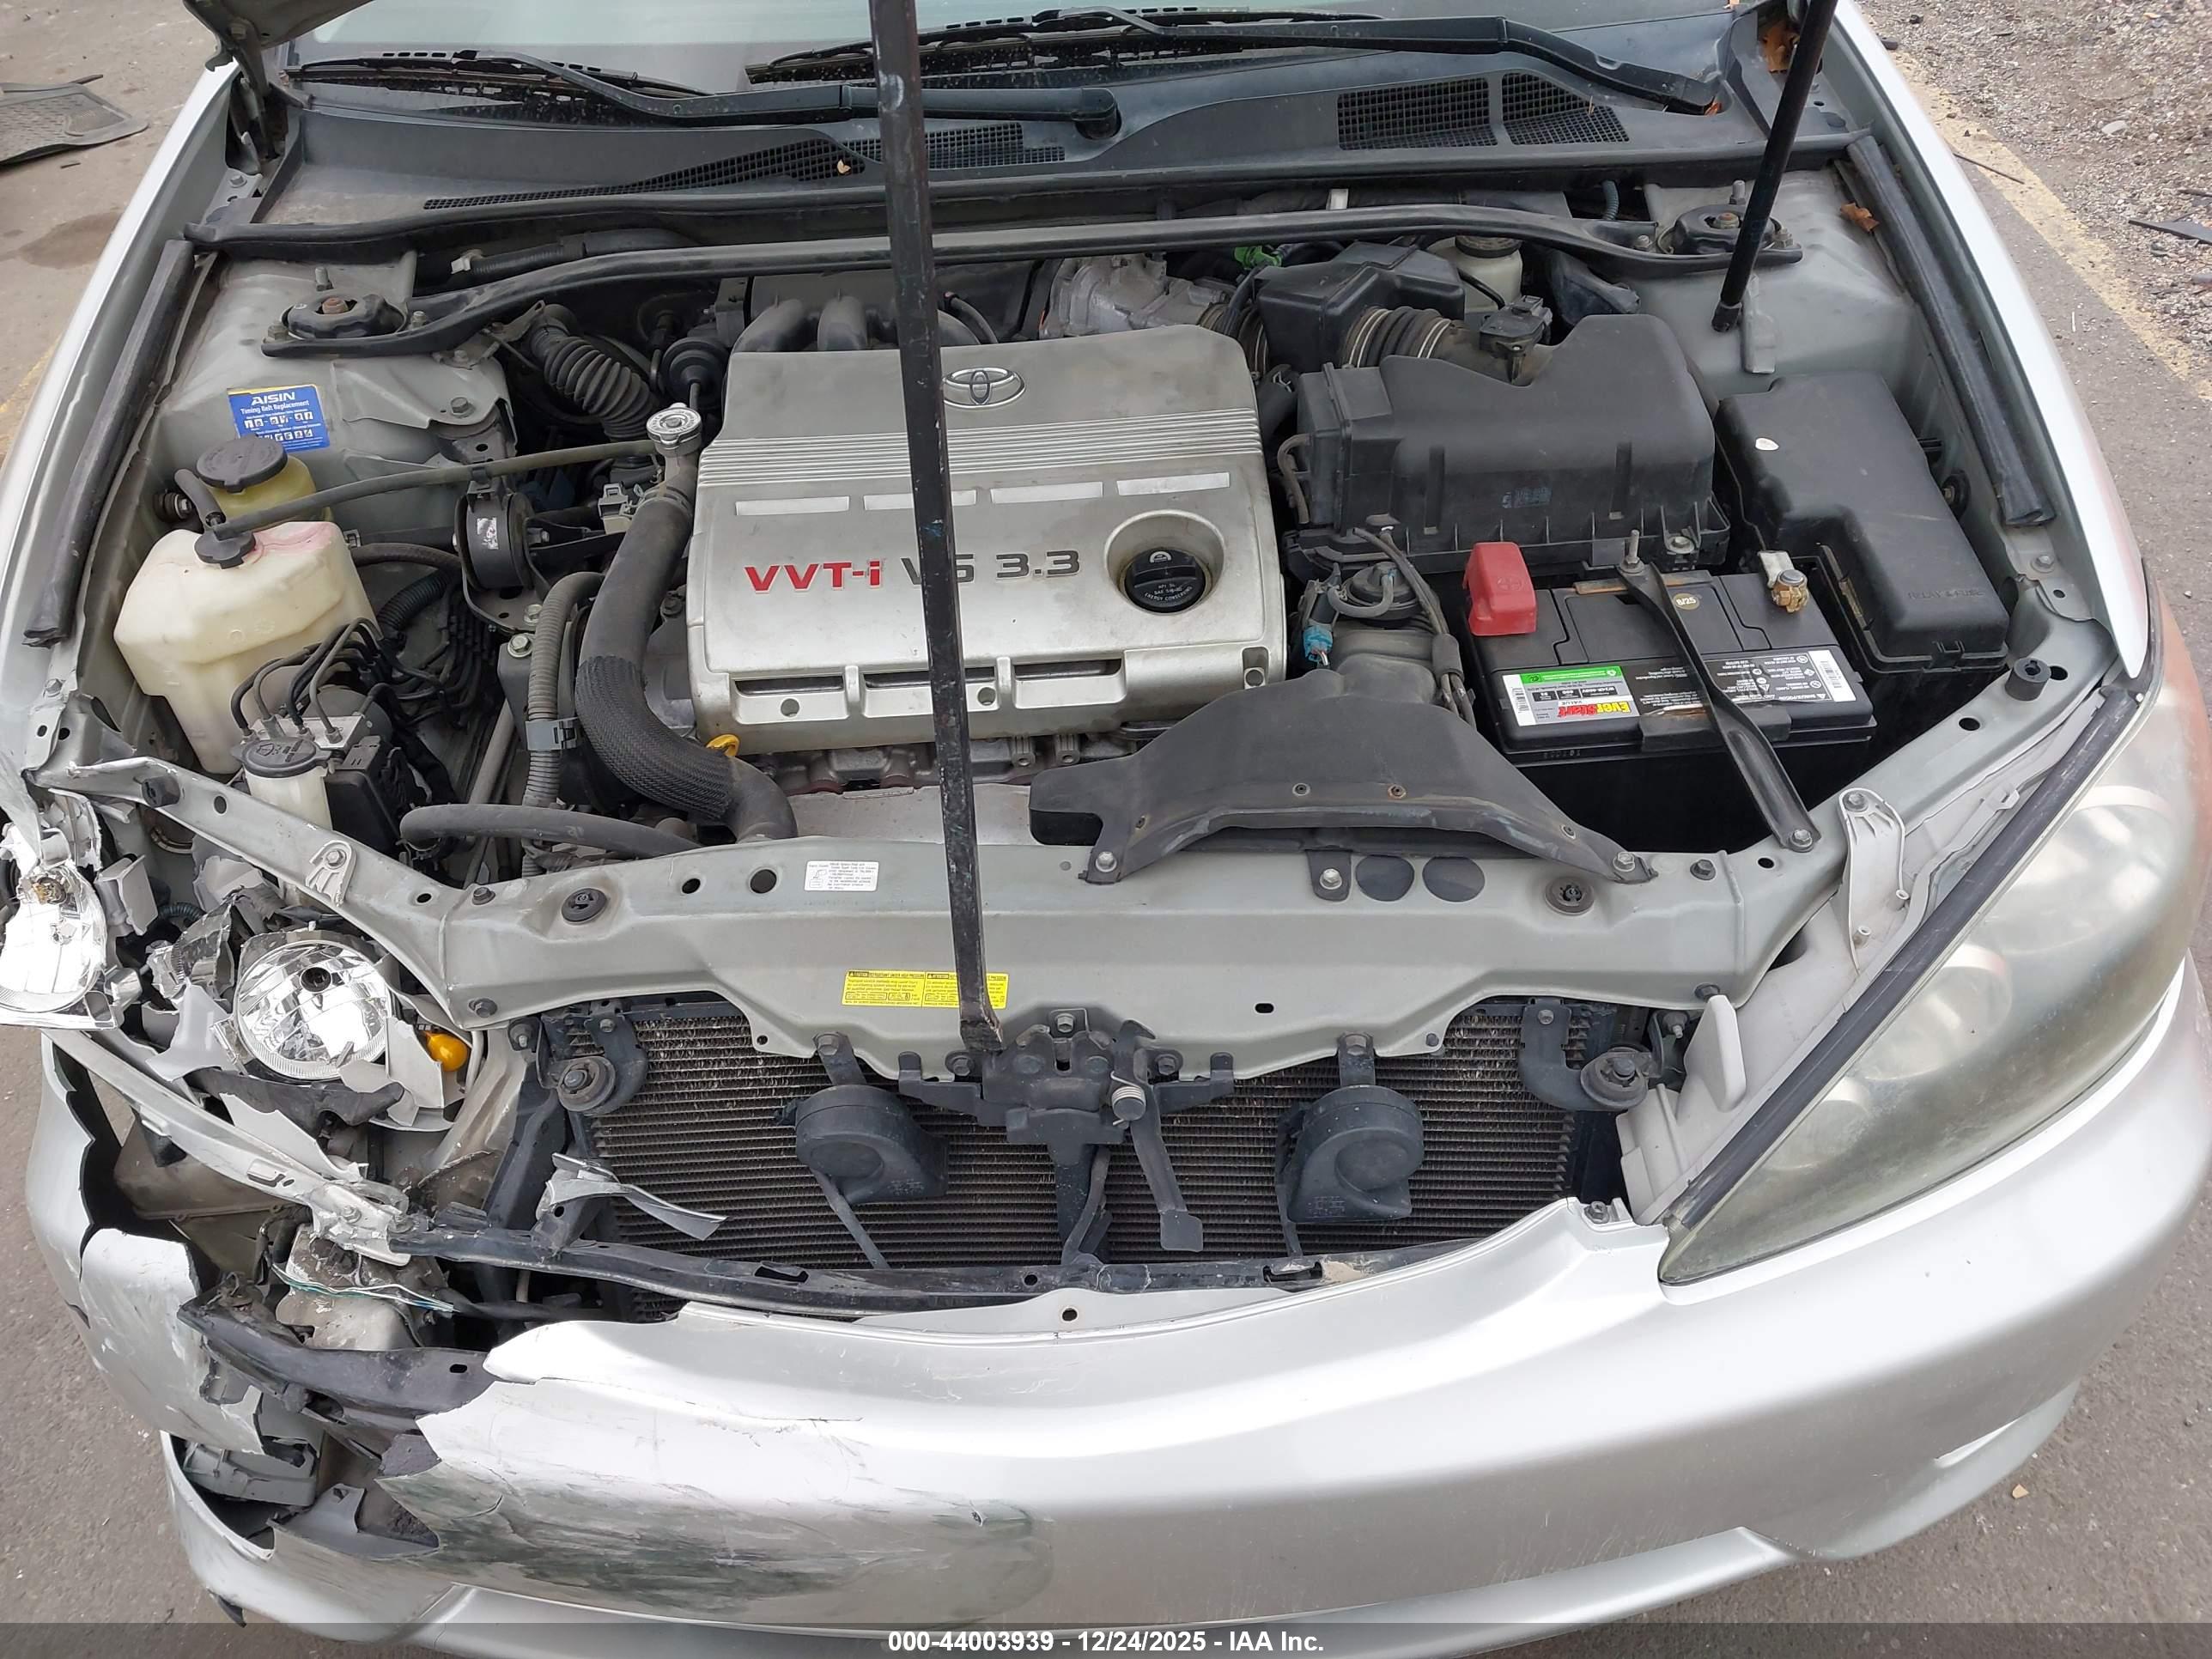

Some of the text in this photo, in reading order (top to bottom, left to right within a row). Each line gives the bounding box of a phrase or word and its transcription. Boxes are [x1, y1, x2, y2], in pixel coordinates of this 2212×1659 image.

[252, 392, 295, 405] AISIN
[240, 406, 261, 415] Timing
[261, 404, 273, 413] Belt
[273, 400, 310, 410] Replacement
[744, 559, 881, 592] VVT-i
[995, 550, 1080, 581] 3.3
[1144, 592, 1164, 601] ENERGY
[1675, 597, 1697, 606] 8/25
[1559, 701, 1632, 717] EverStart
